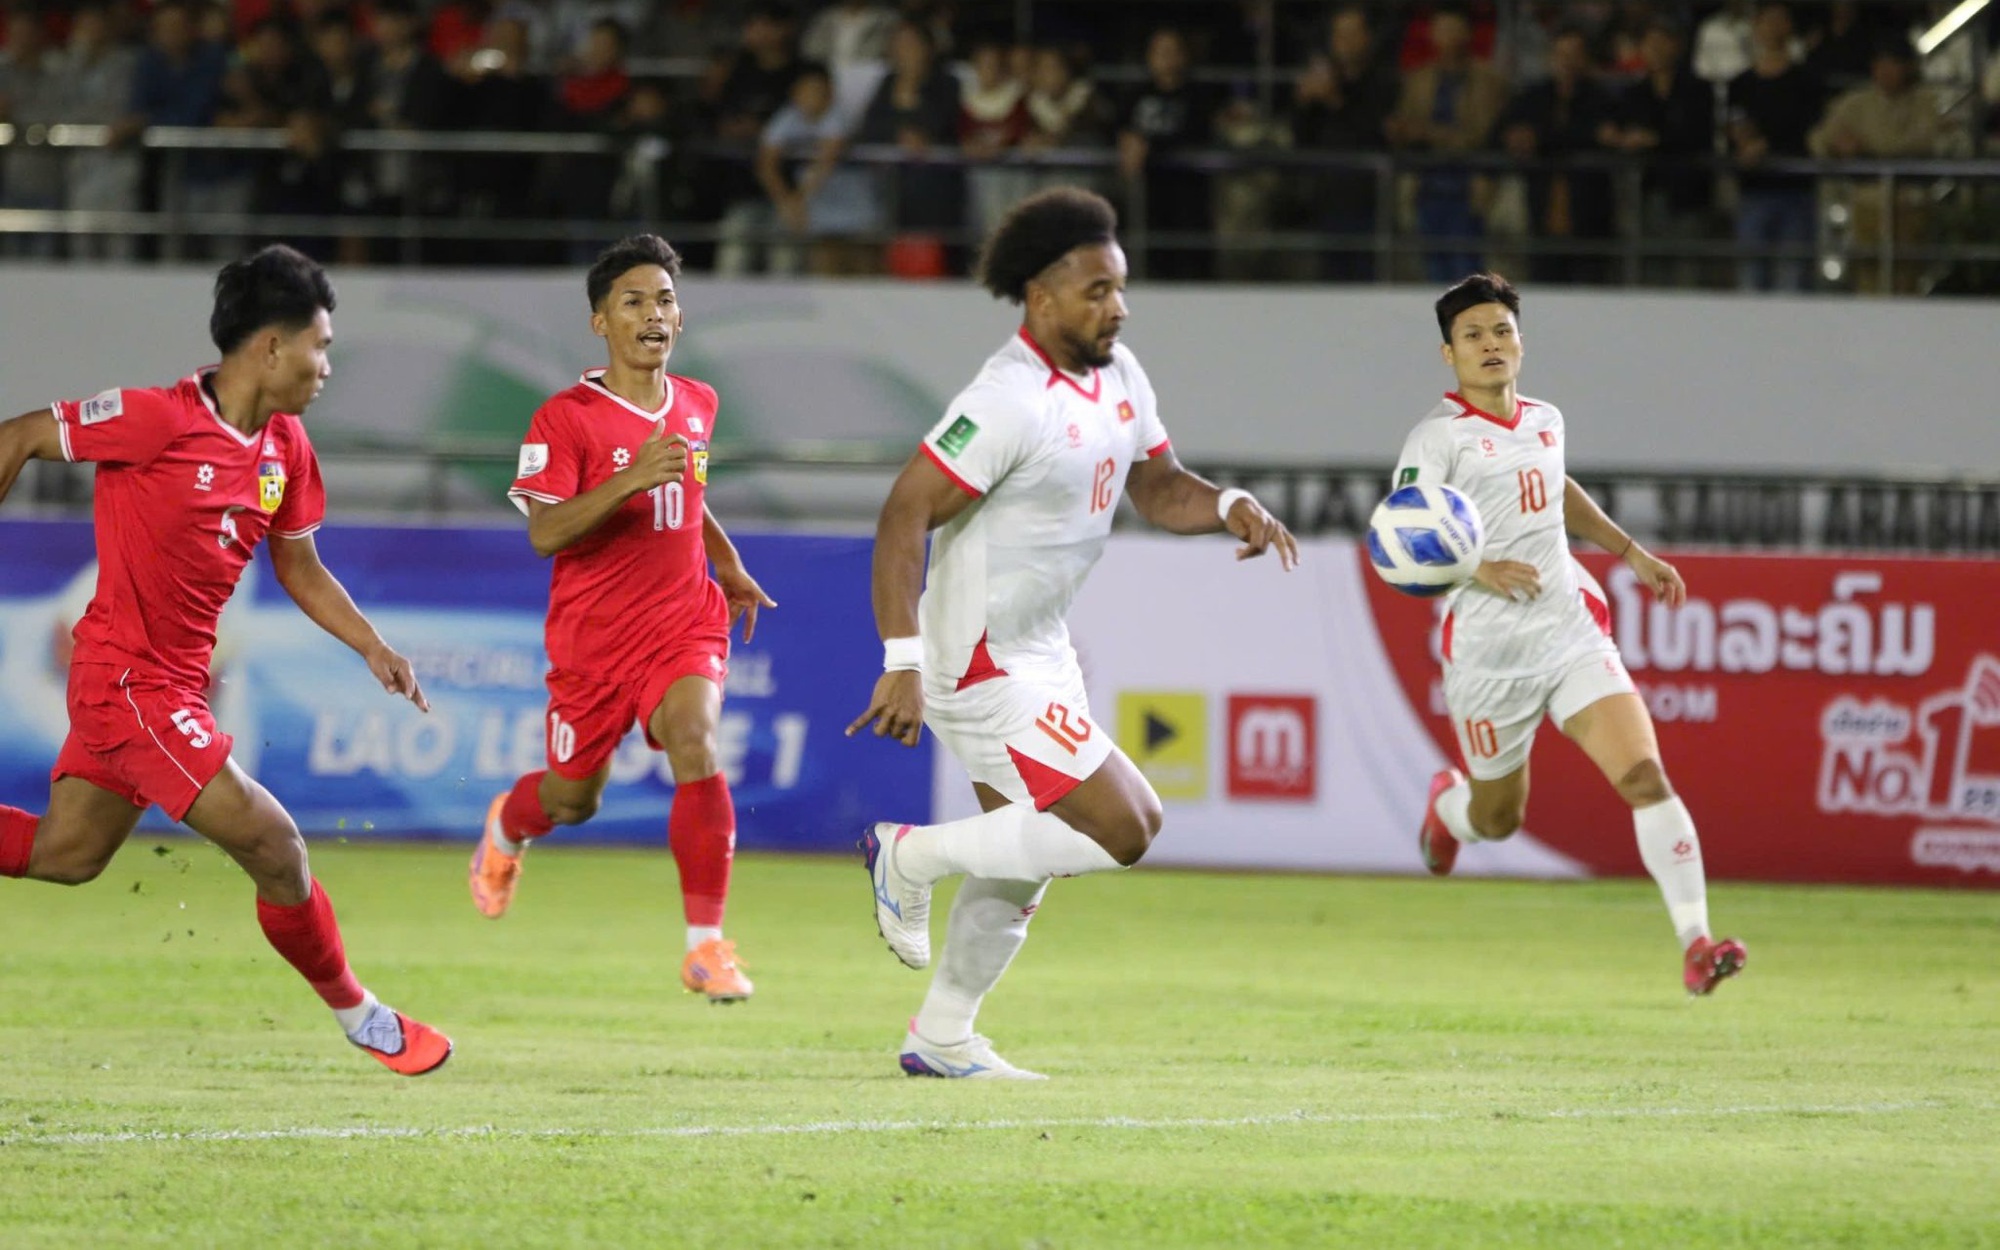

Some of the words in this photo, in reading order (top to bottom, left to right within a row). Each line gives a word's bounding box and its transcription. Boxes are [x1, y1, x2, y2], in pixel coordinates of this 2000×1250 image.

[647, 480, 685, 532] 10
[1089, 456, 1116, 515] 12
[1517, 467, 1547, 515] 10
[217, 505, 247, 549] 5
[169, 708, 212, 749] 5
[309, 708, 456, 778] LAO
[772, 714, 807, 789] 1
[550, 710, 576, 764] 10
[1034, 700, 1093, 758] 12
[1464, 716, 1499, 759] 10
